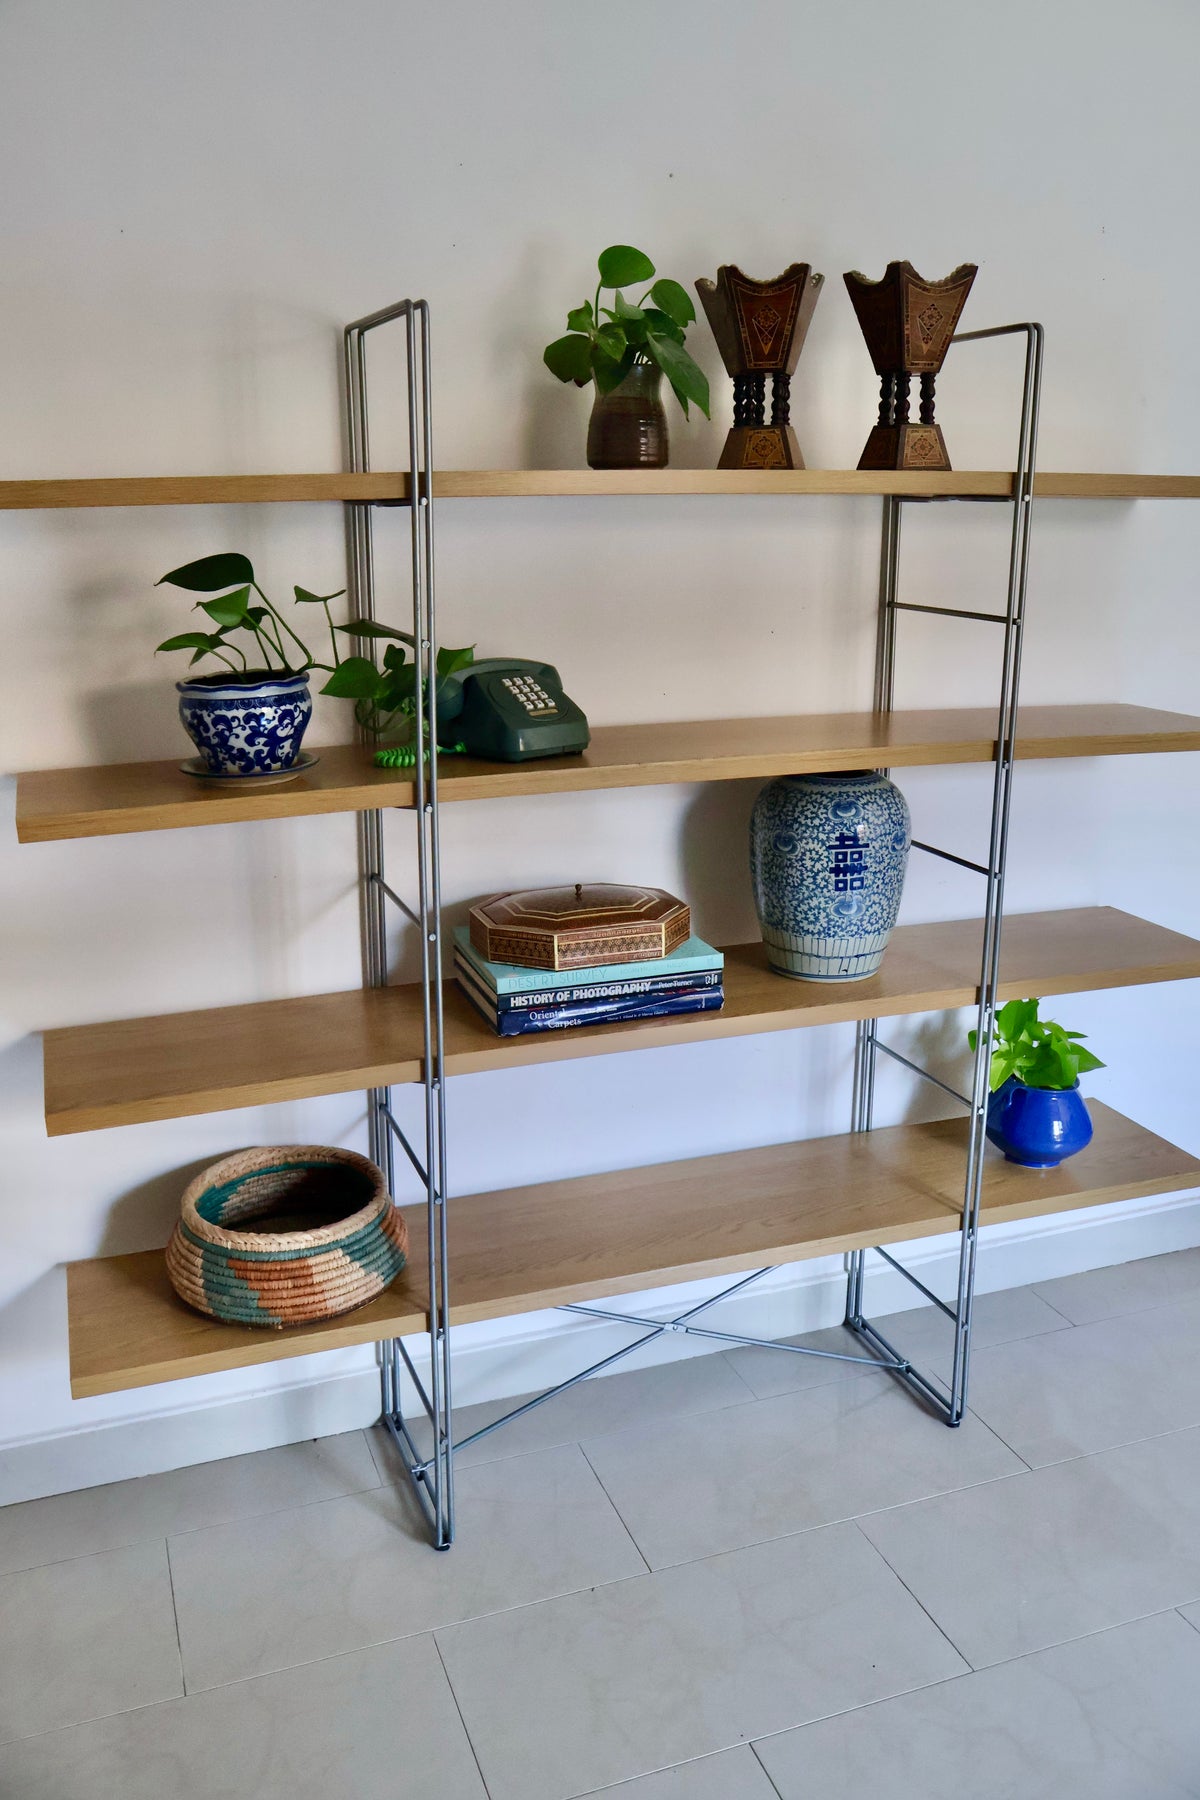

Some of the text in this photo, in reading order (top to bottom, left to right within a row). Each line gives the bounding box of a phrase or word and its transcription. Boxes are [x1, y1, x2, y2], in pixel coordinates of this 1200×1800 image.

[508, 974, 555, 989] DESERT
[559, 968, 607, 984] SURVEY
[658, 979, 694, 989] Peter Turner
[510, 981, 651, 1008] HISTORY OF PHOTOGRAPHY
[547, 1018, 582, 1029] Carpets
